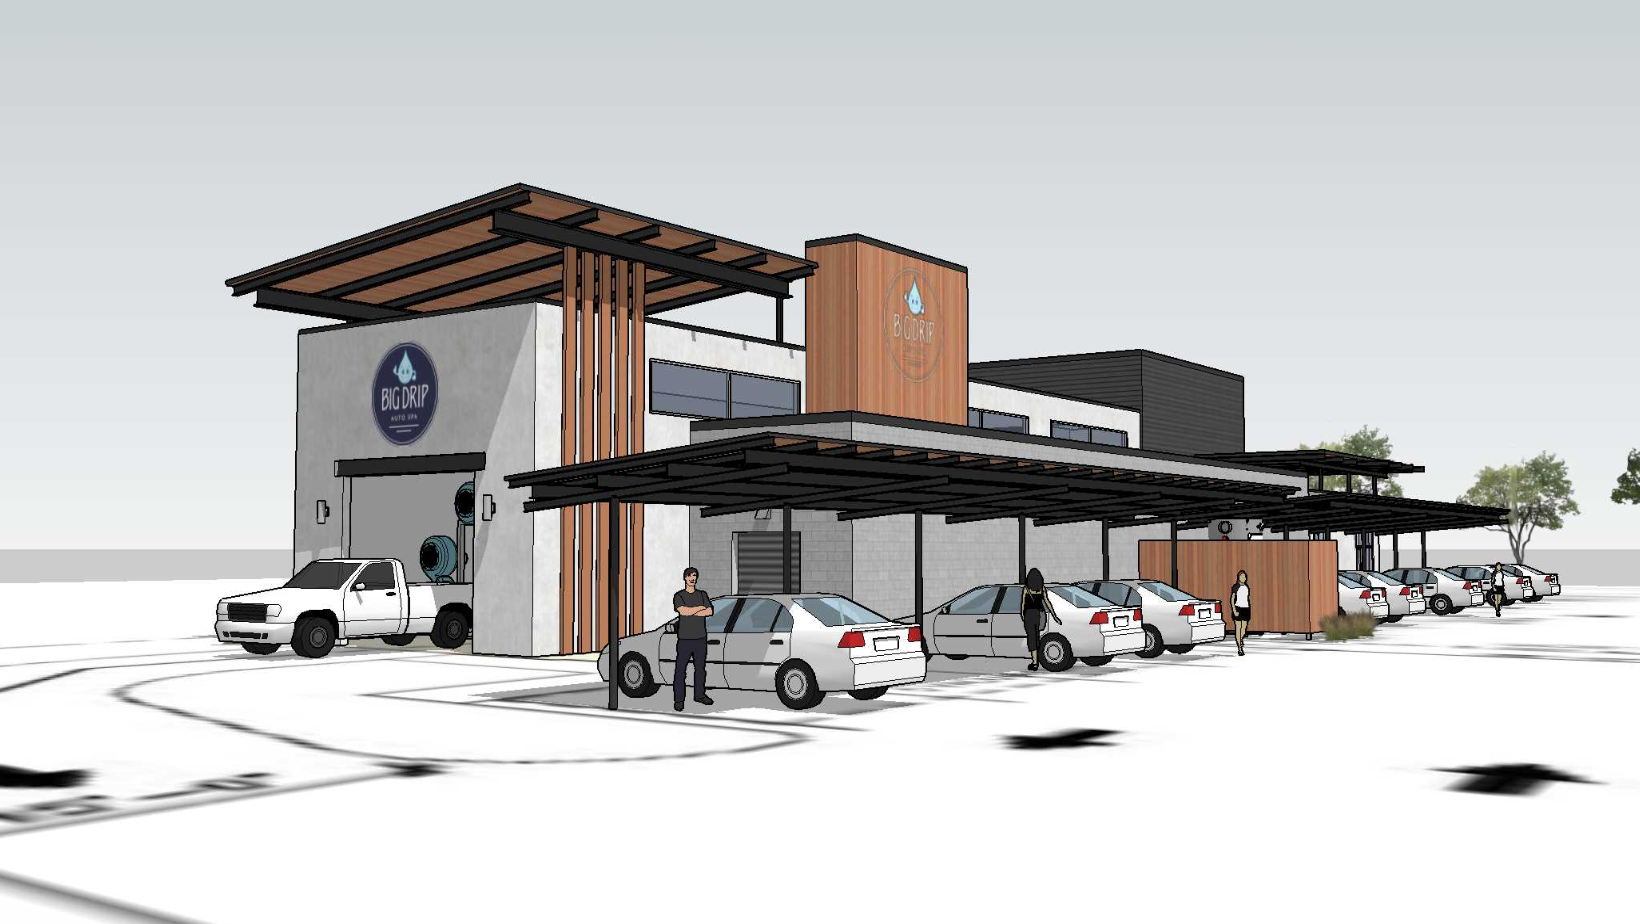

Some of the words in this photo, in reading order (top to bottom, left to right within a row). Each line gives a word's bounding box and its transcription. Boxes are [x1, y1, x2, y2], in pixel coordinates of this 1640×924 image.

[912, 318, 935, 345] DRIP
[381, 386, 400, 411] BIG
[402, 384, 429, 409] DRIP
